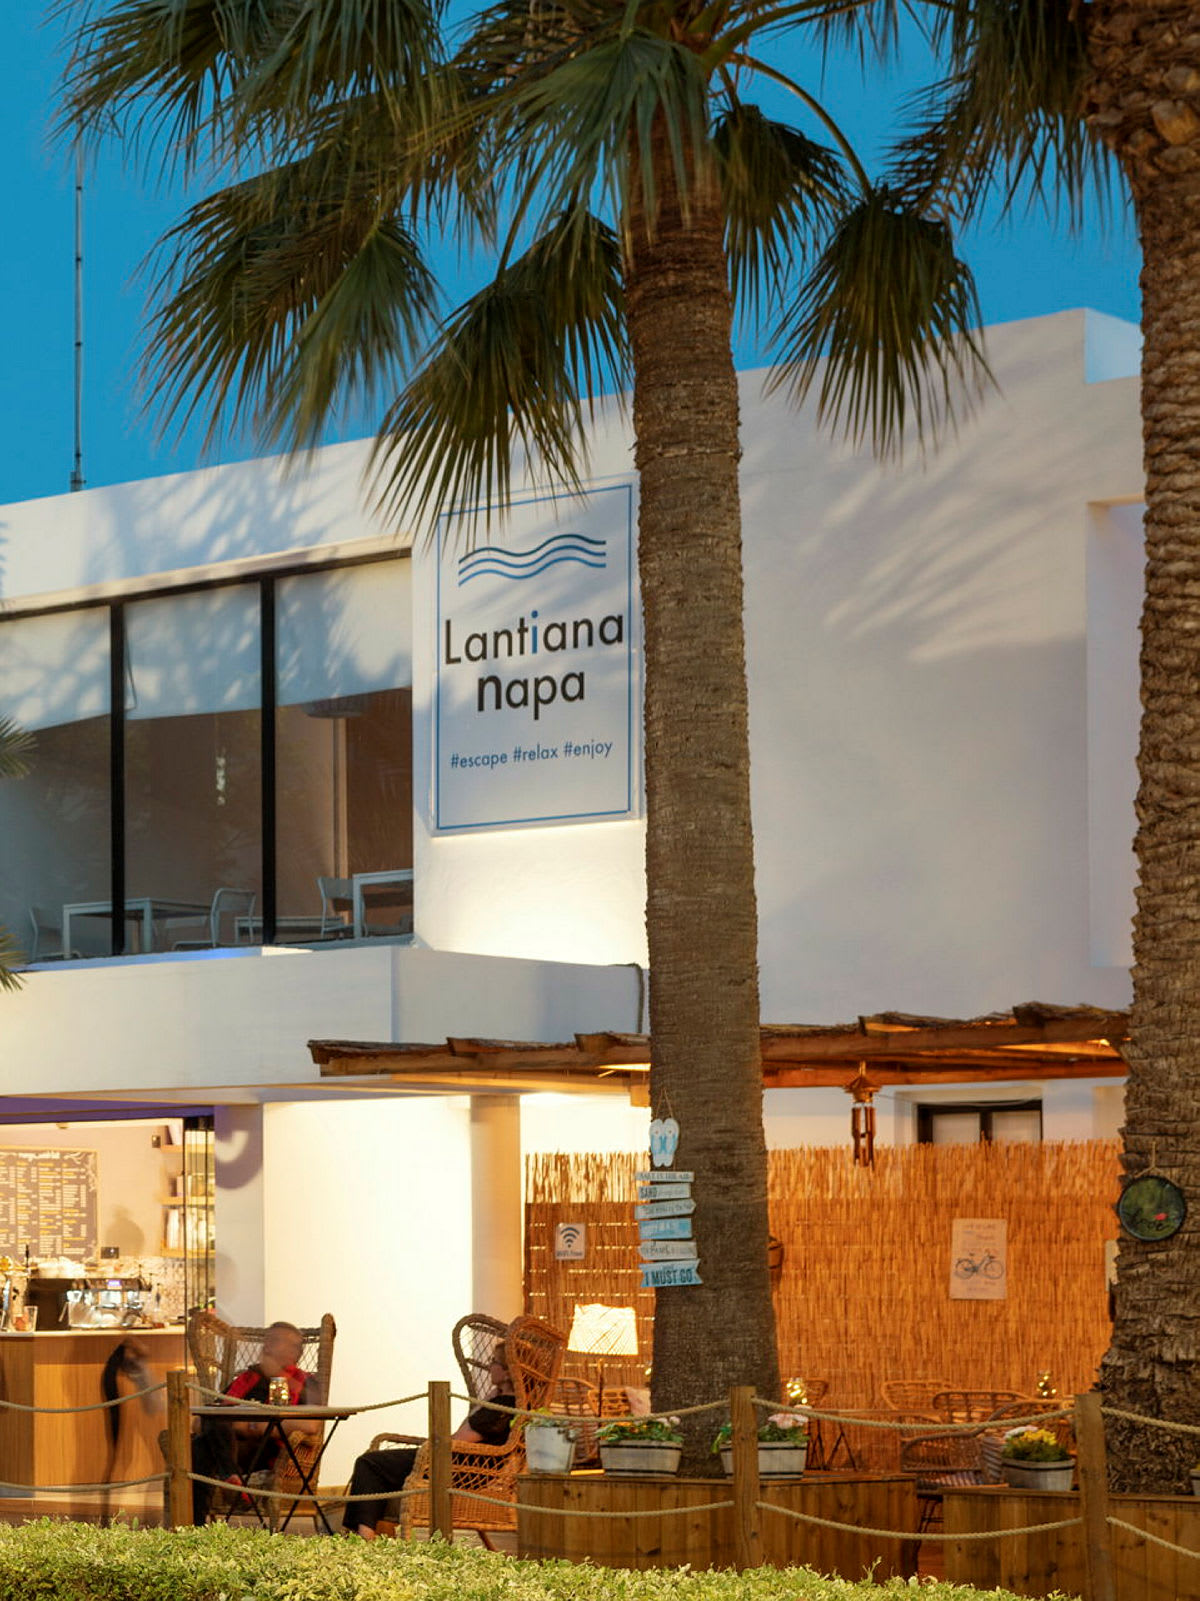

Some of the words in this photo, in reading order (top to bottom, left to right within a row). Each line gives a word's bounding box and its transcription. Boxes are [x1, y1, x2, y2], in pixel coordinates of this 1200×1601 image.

[445, 610, 624, 665] Lantiana
[477, 671, 585, 720] napa
[450, 752, 508, 770] #escape
[513, 745, 558, 762] #relax
[564, 740, 613, 759] #enjoy
[650, 1269, 677, 1285] MUST
[680, 1268, 693, 1283] GO
